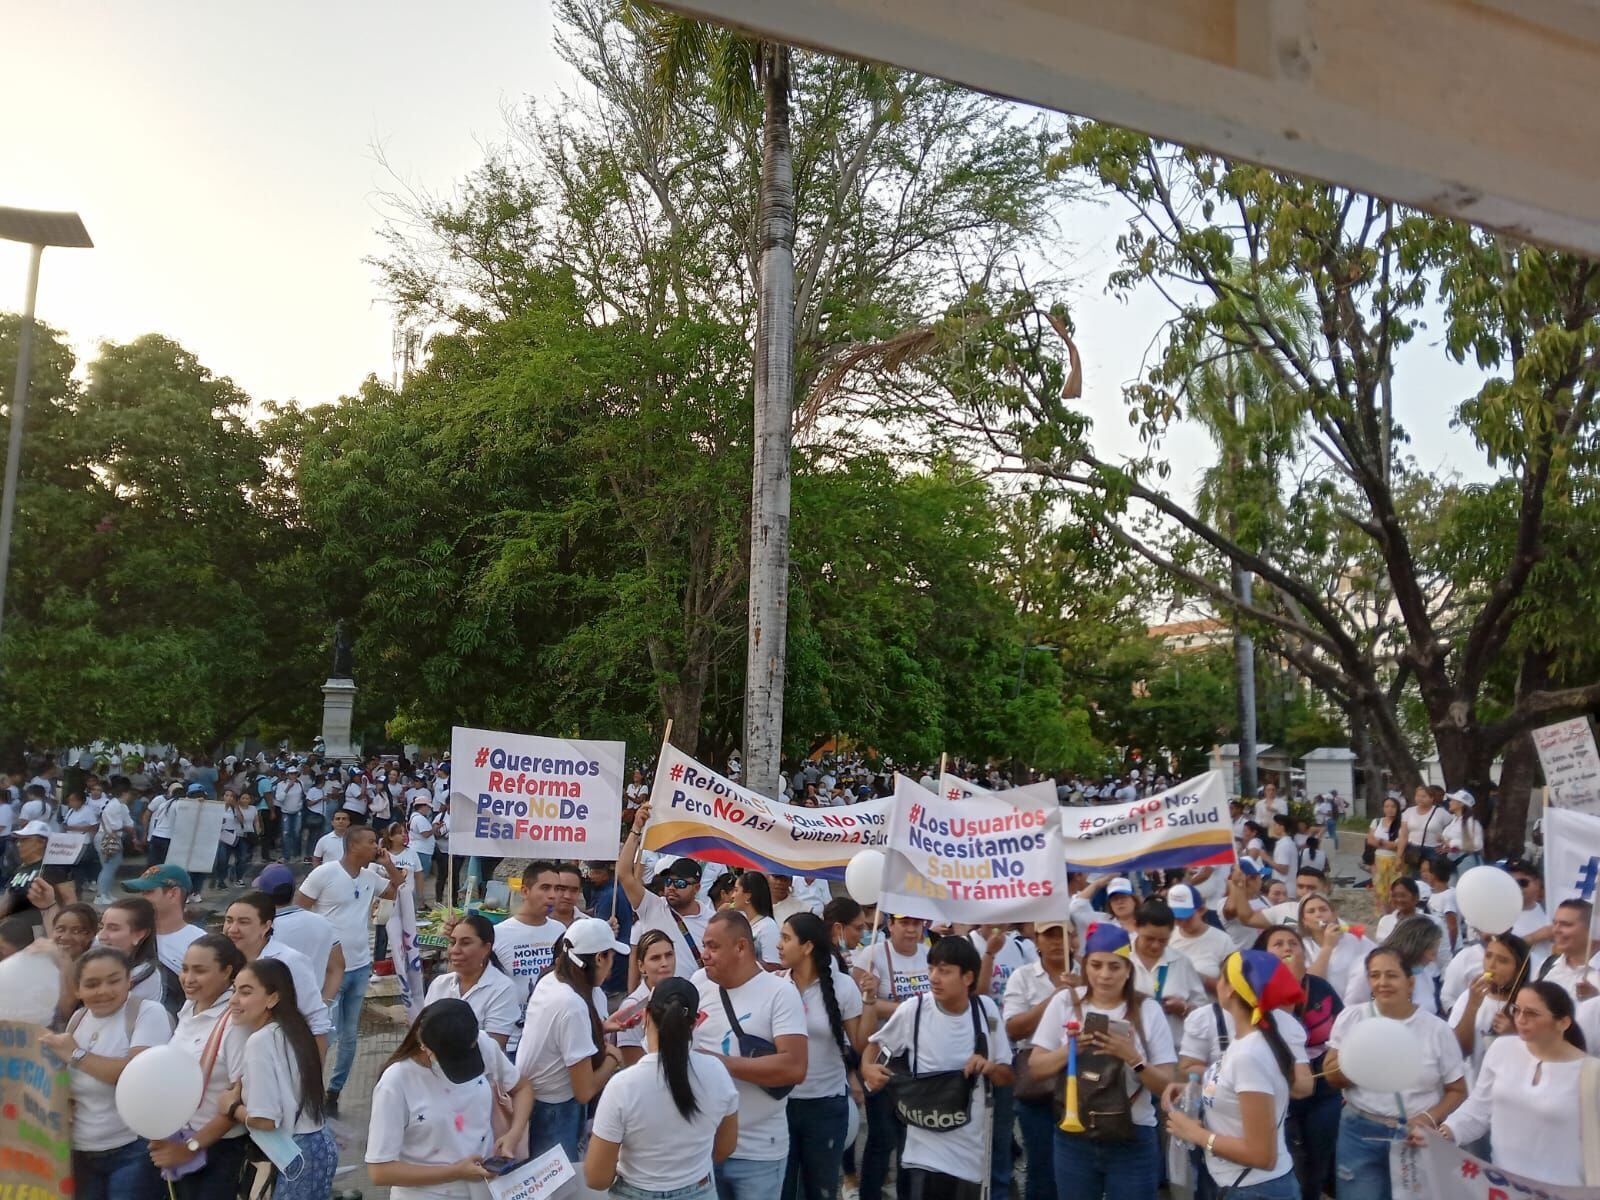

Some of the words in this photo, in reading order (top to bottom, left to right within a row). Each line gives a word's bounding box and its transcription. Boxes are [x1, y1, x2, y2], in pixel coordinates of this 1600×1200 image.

[474, 746, 600, 777] #Queremos
[488, 771, 581, 798] Reforma
[476, 793, 589, 820] PeroNoDe
[1167, 807, 1219, 827] Salud
[475, 816, 587, 843] EsaForma
[909, 803, 1047, 838] #LosUsuarios
[909, 825, 1046, 859] Necesitamos
[927, 855, 1025, 879] SaludNo
